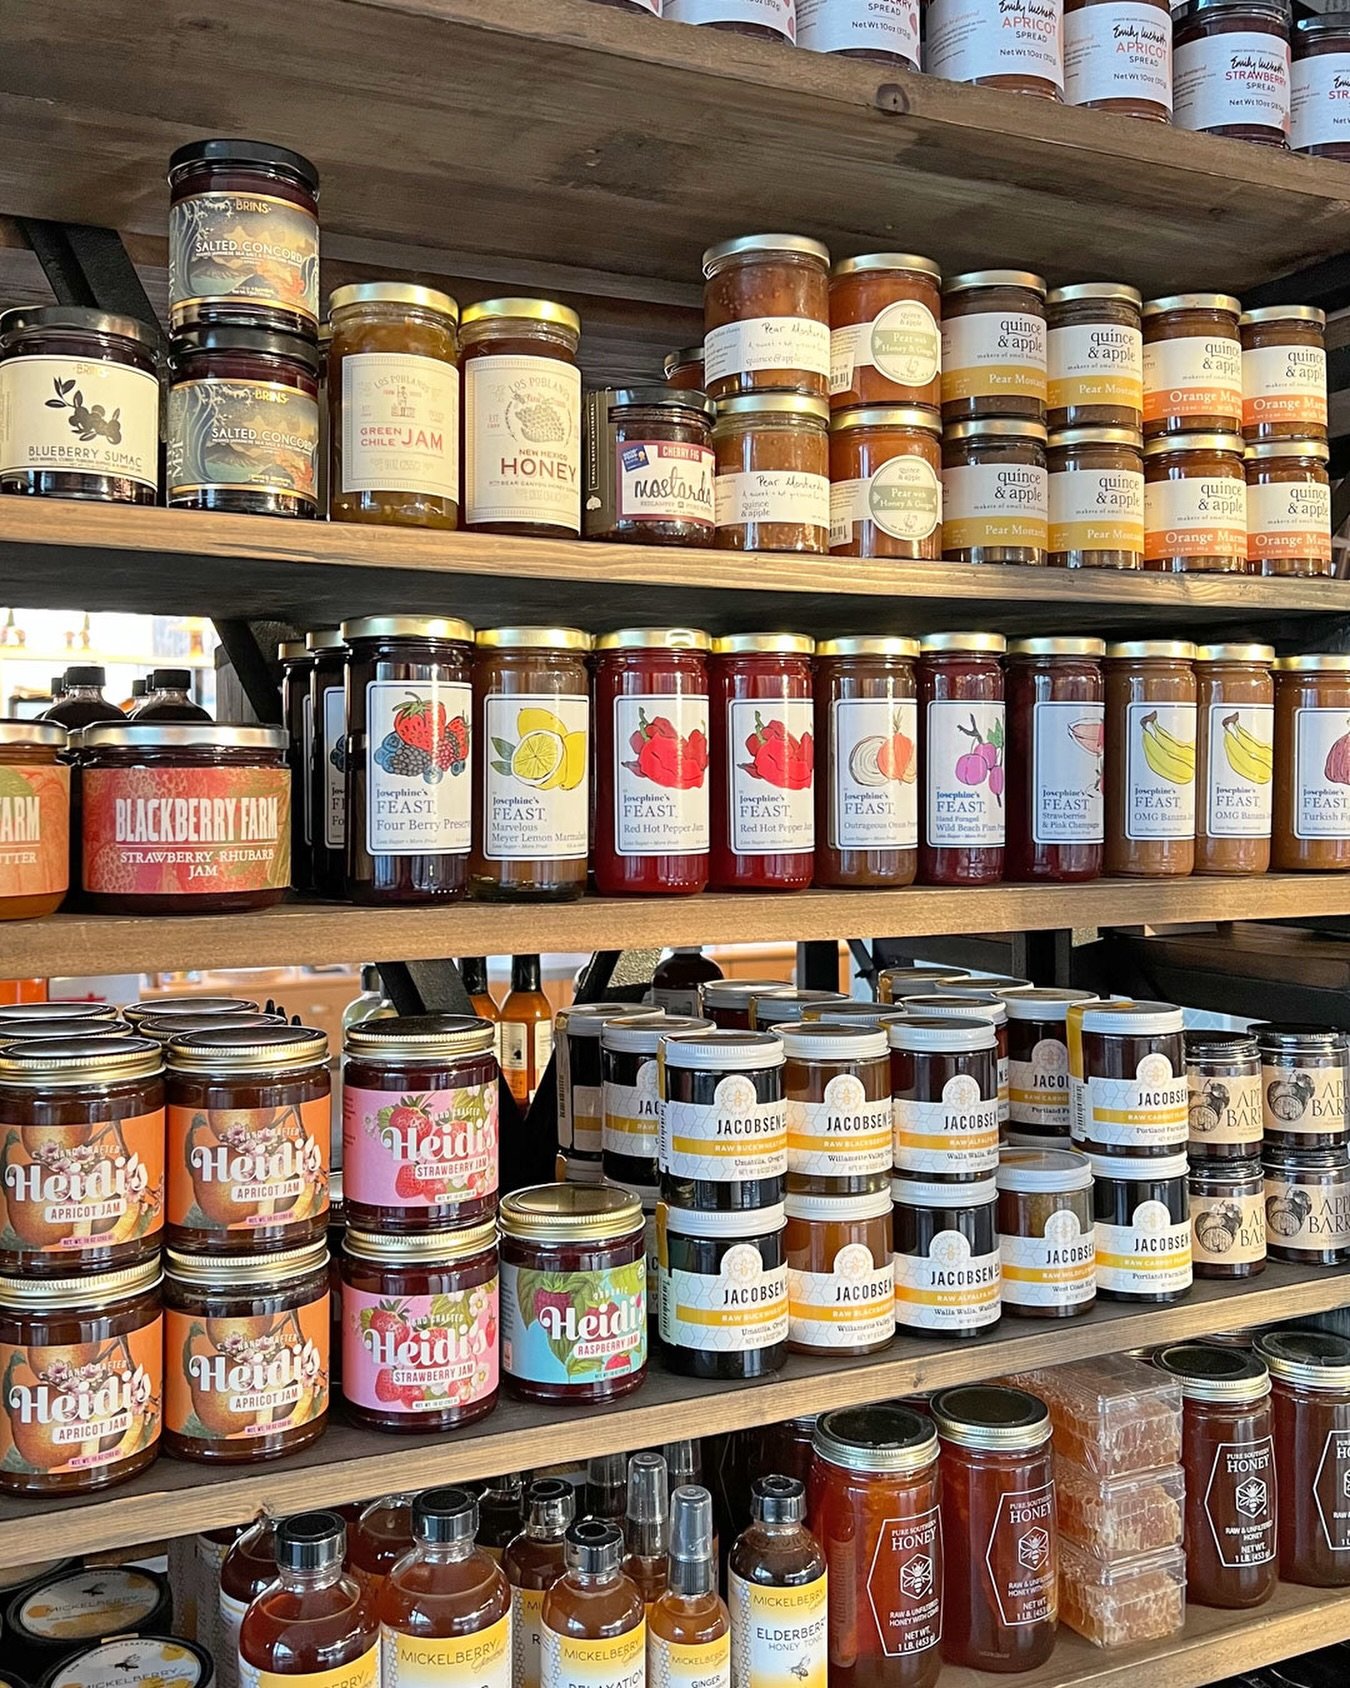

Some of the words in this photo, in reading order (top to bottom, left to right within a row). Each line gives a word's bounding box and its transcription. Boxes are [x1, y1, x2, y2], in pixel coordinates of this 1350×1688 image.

[867, 3, 902, 17] SPREAD
[1001, 16, 1057, 37] APRICOT
[1015, 30, 1047, 43] SPREAD
[1115, 42, 1167, 61] APRICOT
[1128, 55, 1159, 68] SPREAD
[1224, 71, 1287, 89] STRAWBERRY
[1245, 82, 1276, 92] SPREAD
[236, 200, 268, 214] BRINS
[196, 241, 236, 254] SALTED
[242, 241, 302, 266] CONCORD
[1000, 319, 1042, 338] quince
[1090, 329, 1134, 348] quince
[1011, 336, 1043, 356] apple
[1204, 340, 1242, 360] quince
[1101, 347, 1136, 367] apple
[1288, 349, 1324, 368] quince
[988, 372, 1012, 385] Pear
[1079, 383, 1102, 395] Pear
[255, 390, 287, 404] BRINS
[1170, 389, 1212, 405] Orange
[1253, 398, 1296, 412] Orange
[360, 427, 402, 438] GREEN
[402, 429, 444, 450] JAM
[212, 426, 256, 441] SALTED
[262, 429, 313, 455] CONCORD
[361, 438, 395, 447] CHILE
[29, 444, 100, 460] BLUEBERRY
[104, 450, 143, 466] SUMAC
[663, 445, 688, 458] CHERRY
[501, 456, 577, 481] HONEY
[997, 470, 1041, 490] quince
[1098, 475, 1140, 495] quince
[1008, 486, 1042, 506] apple
[1200, 483, 1242, 502] quince
[1290, 483, 1328, 502] quince
[1109, 491, 1141, 510] apple
[1211, 499, 1243, 519] apple
[1300, 501, 1328, 520] apple
[985, 524, 1008, 537] Pear
[1087, 528, 1110, 540] Pear
[1165, 530, 1208, 547] Orange
[1255, 534, 1298, 549] Orange
[376, 787, 429, 800] Josephine's
[843, 791, 889, 804] Josephine's
[936, 789, 981, 802] Josephine's
[1042, 787, 1086, 800] Josephine's
[1134, 786, 1177, 799] Josephine's
[1216, 785, 1257, 798] Josephine's
[1303, 787, 1347, 800] Josephine's
[492, 795, 539, 808] Josephine's
[623, 793, 670, 806] Josephine's
[740, 793, 785, 806] Josephine's
[1042, 798, 1090, 812] FEAST
[1134, 796, 1180, 810] FEAST
[1216, 795, 1260, 809] FEAST
[1303, 797, 1350, 811] FEAST
[376, 799, 434, 815] FEAST
[623, 804, 676, 819] FEAST
[740, 805, 789, 819] FEAST
[843, 802, 893, 816] FEAST
[936, 801, 986, 815] FEAST
[115, 798, 236, 843] BLACKBERRY
[240, 797, 278, 841] FARM
[492, 807, 545, 822] FEAST
[1134, 811, 1158, 822] OMG
[1215, 810, 1238, 821] OMG
[1303, 811, 1338, 822] Turkish
[376, 819, 405, 833] Four
[408, 818, 440, 835] Berry
[491, 822, 538, 833] Marvelous
[623, 823, 640, 834] Red
[642, 823, 660, 834] Hot
[662, 824, 690, 838] Pepper
[740, 823, 757, 834] Red
[758, 823, 776, 834] Hot
[778, 824, 803, 837] Pepper
[936, 823, 955, 833] Wild
[957, 823, 981, 833] Beach
[1050, 820, 1068, 831] Pink
[490, 833, 520, 846] Meyer
[521, 832, 552, 844] Lemon
[120, 852, 214, 865] STRAWBERRY
[219, 850, 274, 862] RHUBARB
[188, 865, 218, 881] JAM
[1032, 1107, 1060, 1116] Portland
[1128, 1113, 1145, 1122] RAW
[716, 1115, 782, 1138] JACOBSEN
[826, 1113, 890, 1135] JACOBSEN
[1136, 1126, 1166, 1137] Portland
[379, 1118, 496, 1163] Heidi's
[823, 1139, 845, 1149] RAW
[949, 1137, 968, 1147] RAW
[714, 1143, 736, 1154] RAW
[190, 1133, 322, 1188] Heidi's
[827, 1153, 868, 1165] Willamette
[946, 1152, 967, 1161] Walla
[416, 1161, 474, 1178] STRAWBERRY
[475, 1158, 489, 1173] JAM
[5, 1155, 150, 1203] Heidi's
[236, 1185, 280, 1201] APRICOT
[282, 1183, 300, 1197] JAM
[50, 1204, 98, 1221] APRICOT
[100, 1201, 121, 1217] JAM
[1124, 1258, 1145, 1269] RAW
[930, 1265, 994, 1288] JACOBSEN
[1042, 1271, 1061, 1281] RAW
[1132, 1272, 1162, 1282] Portland
[937, 1293, 956, 1303] RAW
[721, 1312, 742, 1324] RAW
[832, 1308, 852, 1319] RAW
[934, 1308, 955, 1318] Walla
[837, 1322, 875, 1336] Willamette
[362, 1321, 489, 1369] Heidi's
[577, 1337, 624, 1358] RASPBERRY
[624, 1332, 639, 1348] JAM
[189, 1337, 321, 1394] Heidi's
[394, 1366, 455, 1385] STRAWBERRY
[457, 1362, 473, 1379] JAM
[9, 1360, 152, 1425] Heidi's
[235, 1392, 280, 1410] APRICOT
[280, 1387, 300, 1403] JAM
[58, 1422, 106, 1442] APRICOT
[107, 1416, 128, 1433] JAM
[1226, 1454, 1270, 1473] HONEY
[1009, 1502, 1052, 1524] HONEY
[891, 1527, 909, 1538] PURE
[1225, 1526, 1241, 1535] RAW
[1243, 1532, 1263, 1541] HONEY
[891, 1527, 937, 1552] HONEY
[1008, 1582, 1023, 1590] RAW
[754, 1588, 824, 1608] MICKELBERRY
[1008, 1589, 1031, 1598] HONEY
[1022, 1601, 1036, 1611] NET
[889, 1611, 905, 1620] RAW
[889, 1617, 910, 1627] HONEY
[910, 1613, 927, 1624] WITH
[904, 1630, 919, 1641] NET
[564, 1638, 641, 1667] MICKELBERRY
[768, 1642, 800, 1652] HONEY
[903, 1640, 915, 1651] LB.
[401, 1641, 497, 1669] MICKELBERRY
[691, 1674, 721, 1688] GINGER
